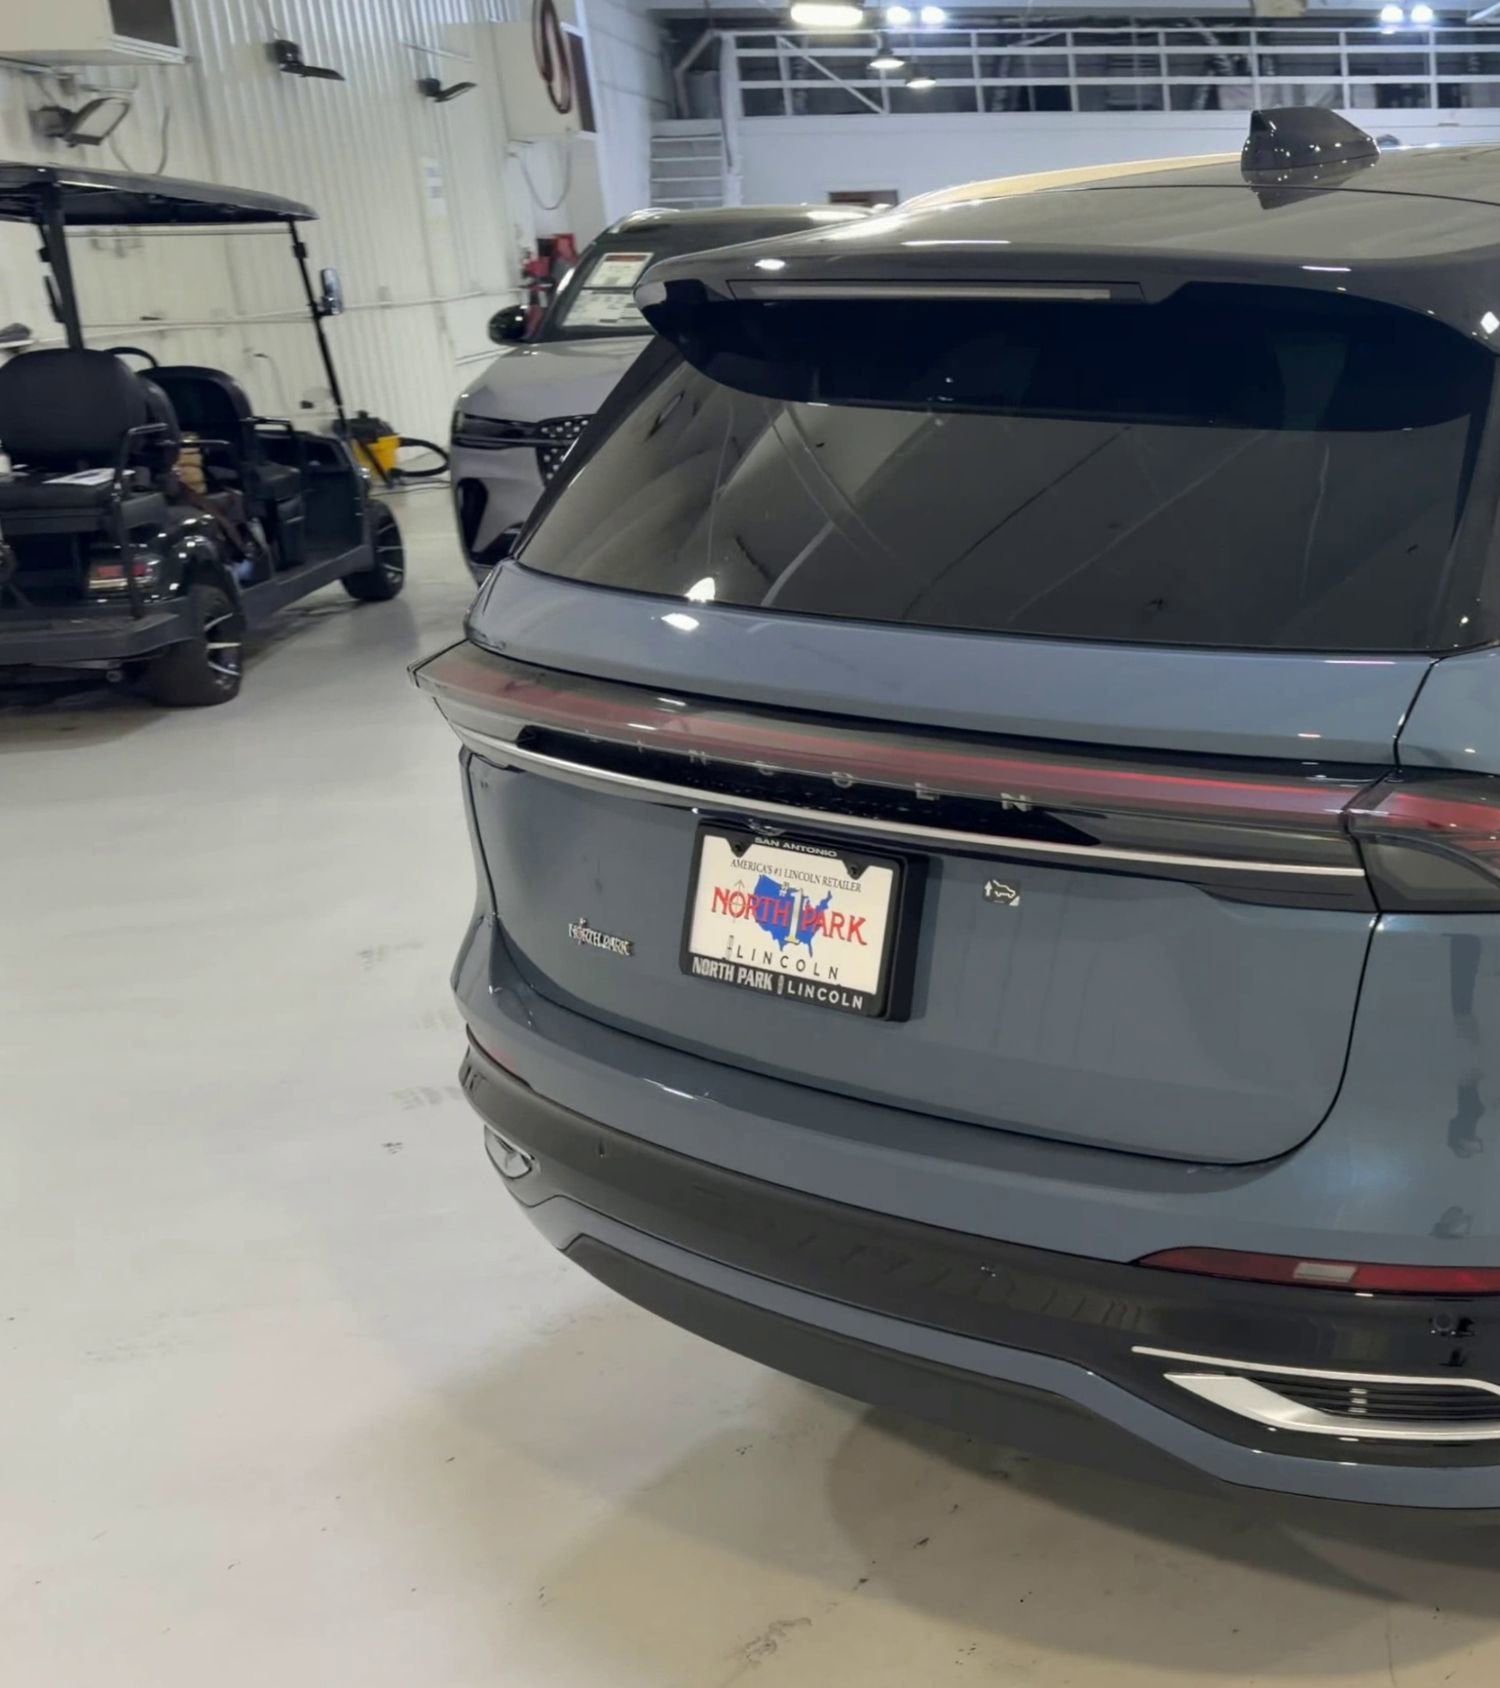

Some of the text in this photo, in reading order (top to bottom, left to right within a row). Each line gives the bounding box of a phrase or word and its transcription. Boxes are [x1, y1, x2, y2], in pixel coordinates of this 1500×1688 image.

[754, 836, 838, 857] SAN ANTONIO
[730, 858, 773, 875] AMERICA'S
[784, 868, 822, 884] LINCOLN
[821, 876, 862, 893] RETAILER
[711, 886, 868, 946] NORTH PARK
[736, 945, 839, 979] LINCOLN
[692, 956, 864, 1010] NORTH PARK LINCOLN
